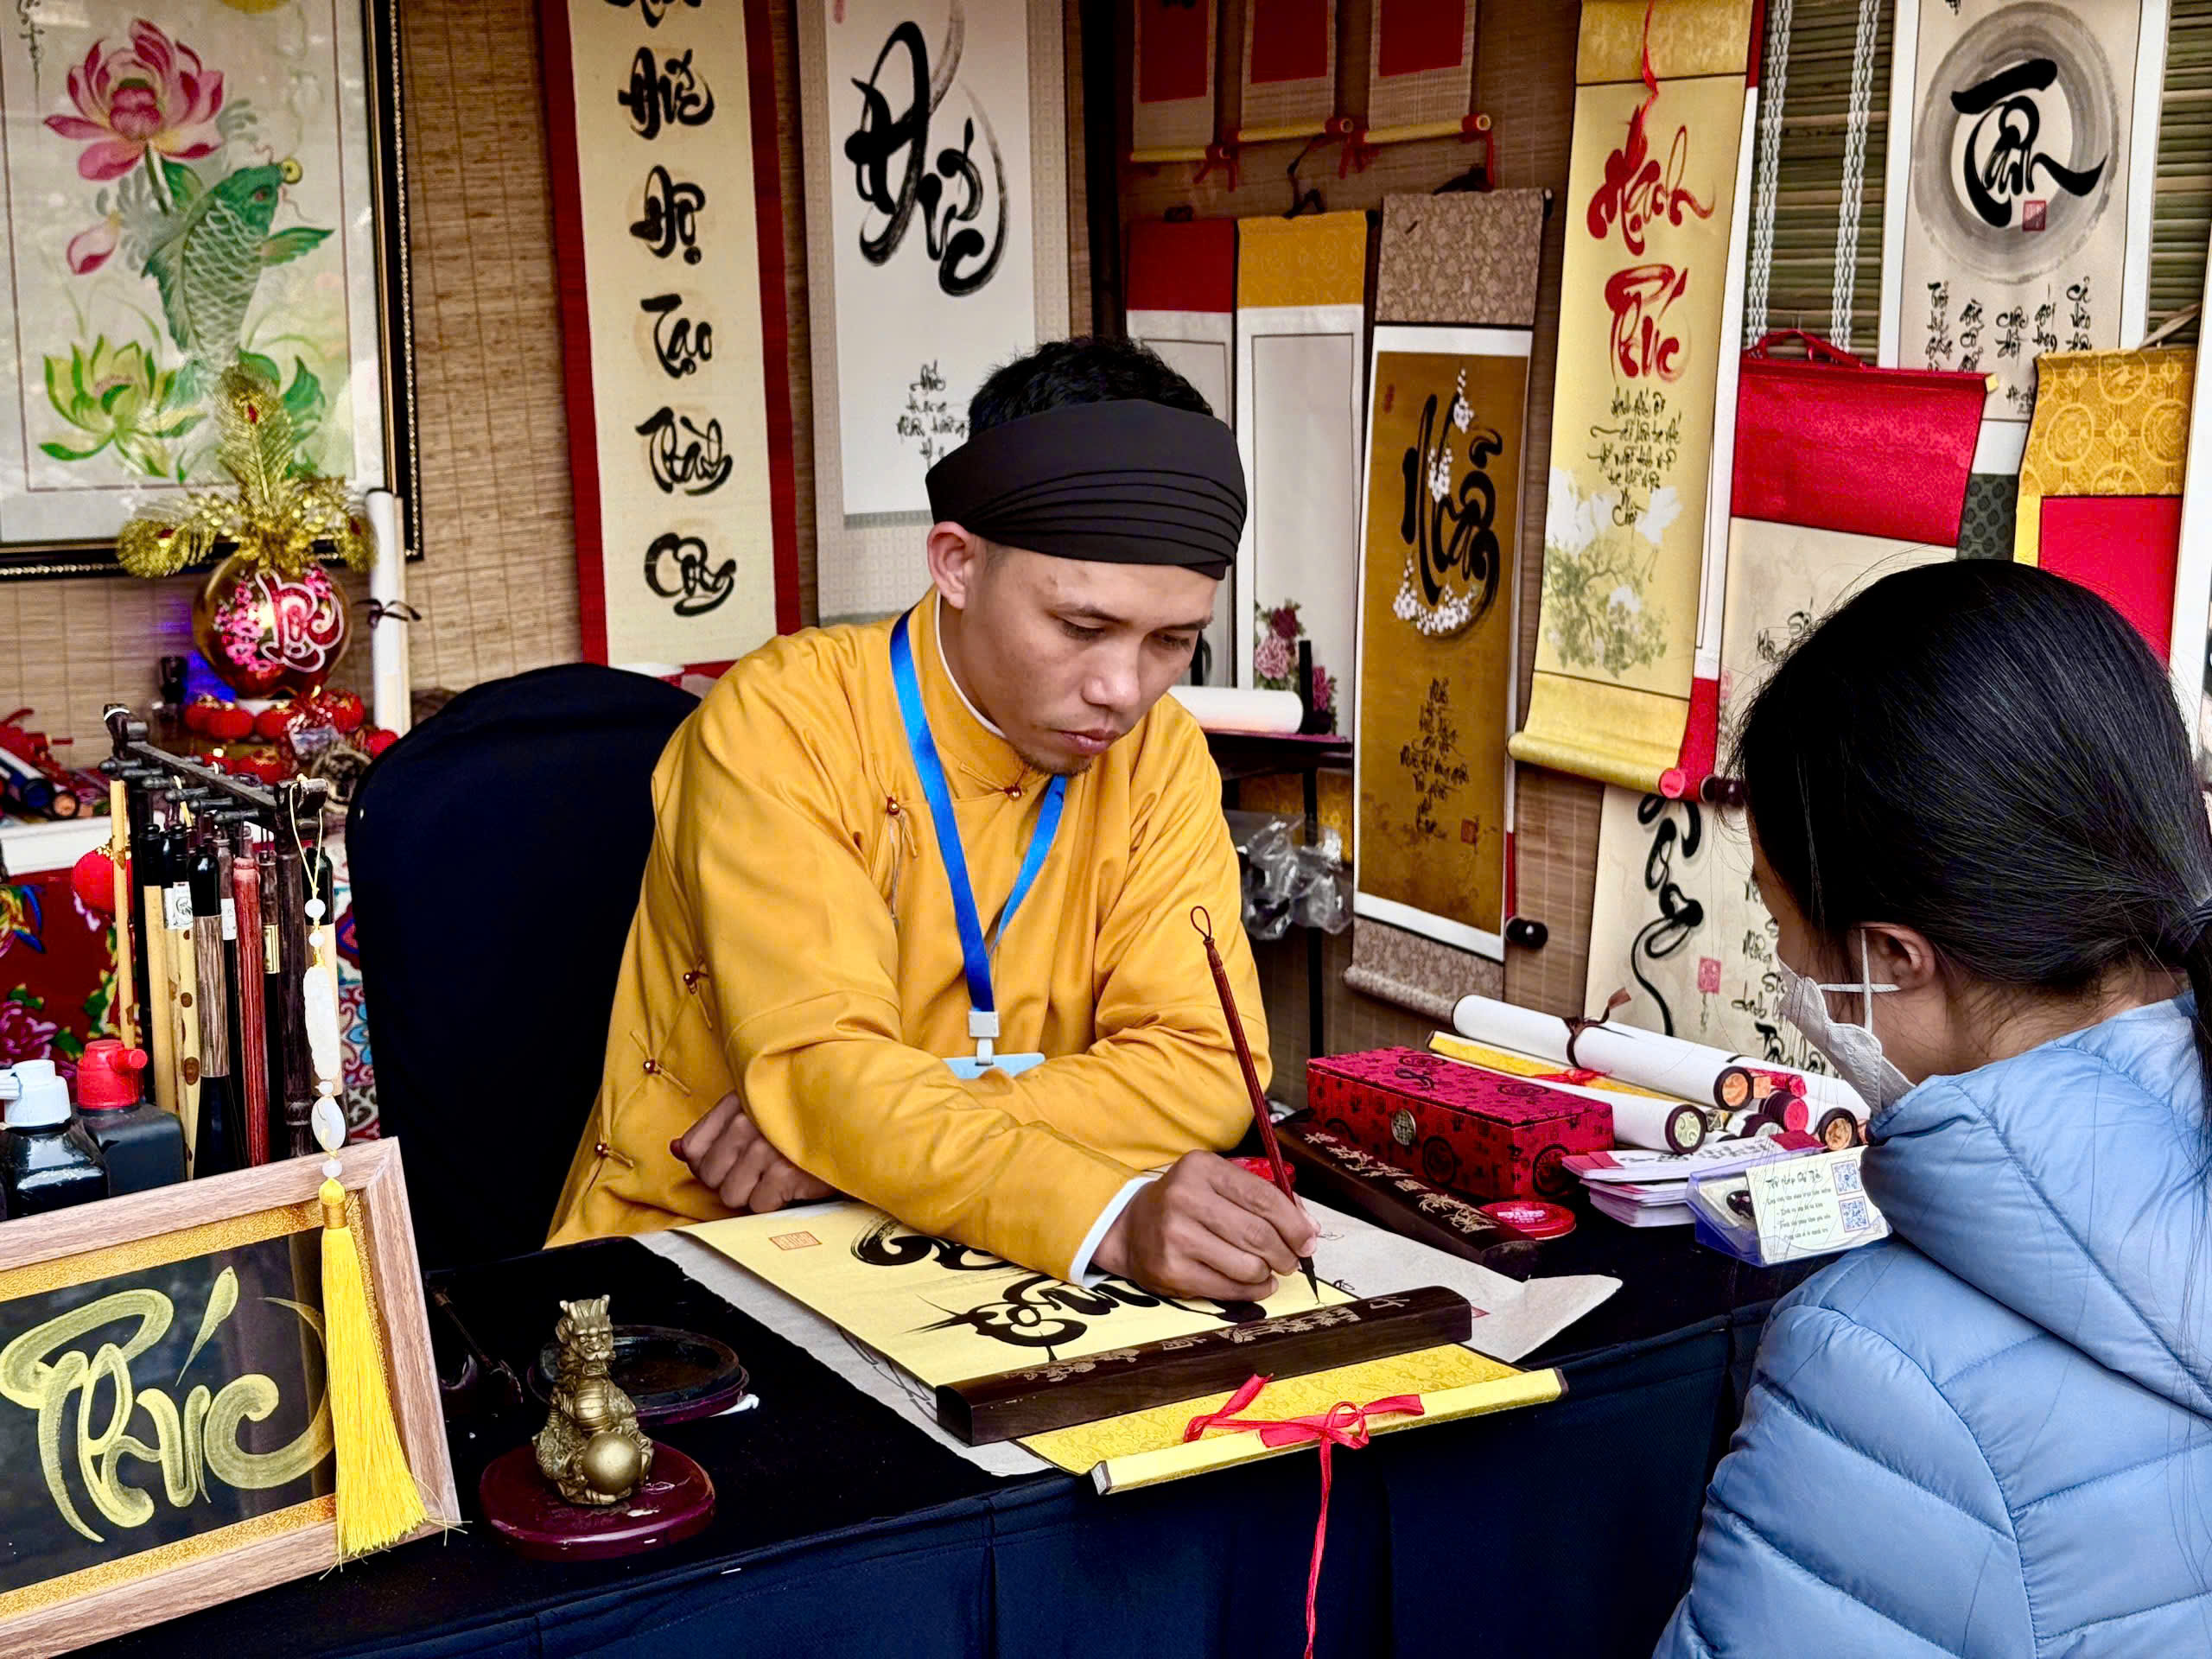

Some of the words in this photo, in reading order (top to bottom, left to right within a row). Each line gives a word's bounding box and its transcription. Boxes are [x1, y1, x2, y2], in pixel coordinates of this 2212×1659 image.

[640, 293, 714, 378] Tạo
[1604, 263, 1692, 383] Phúc
[0, 1265, 335, 1542] Phúc
